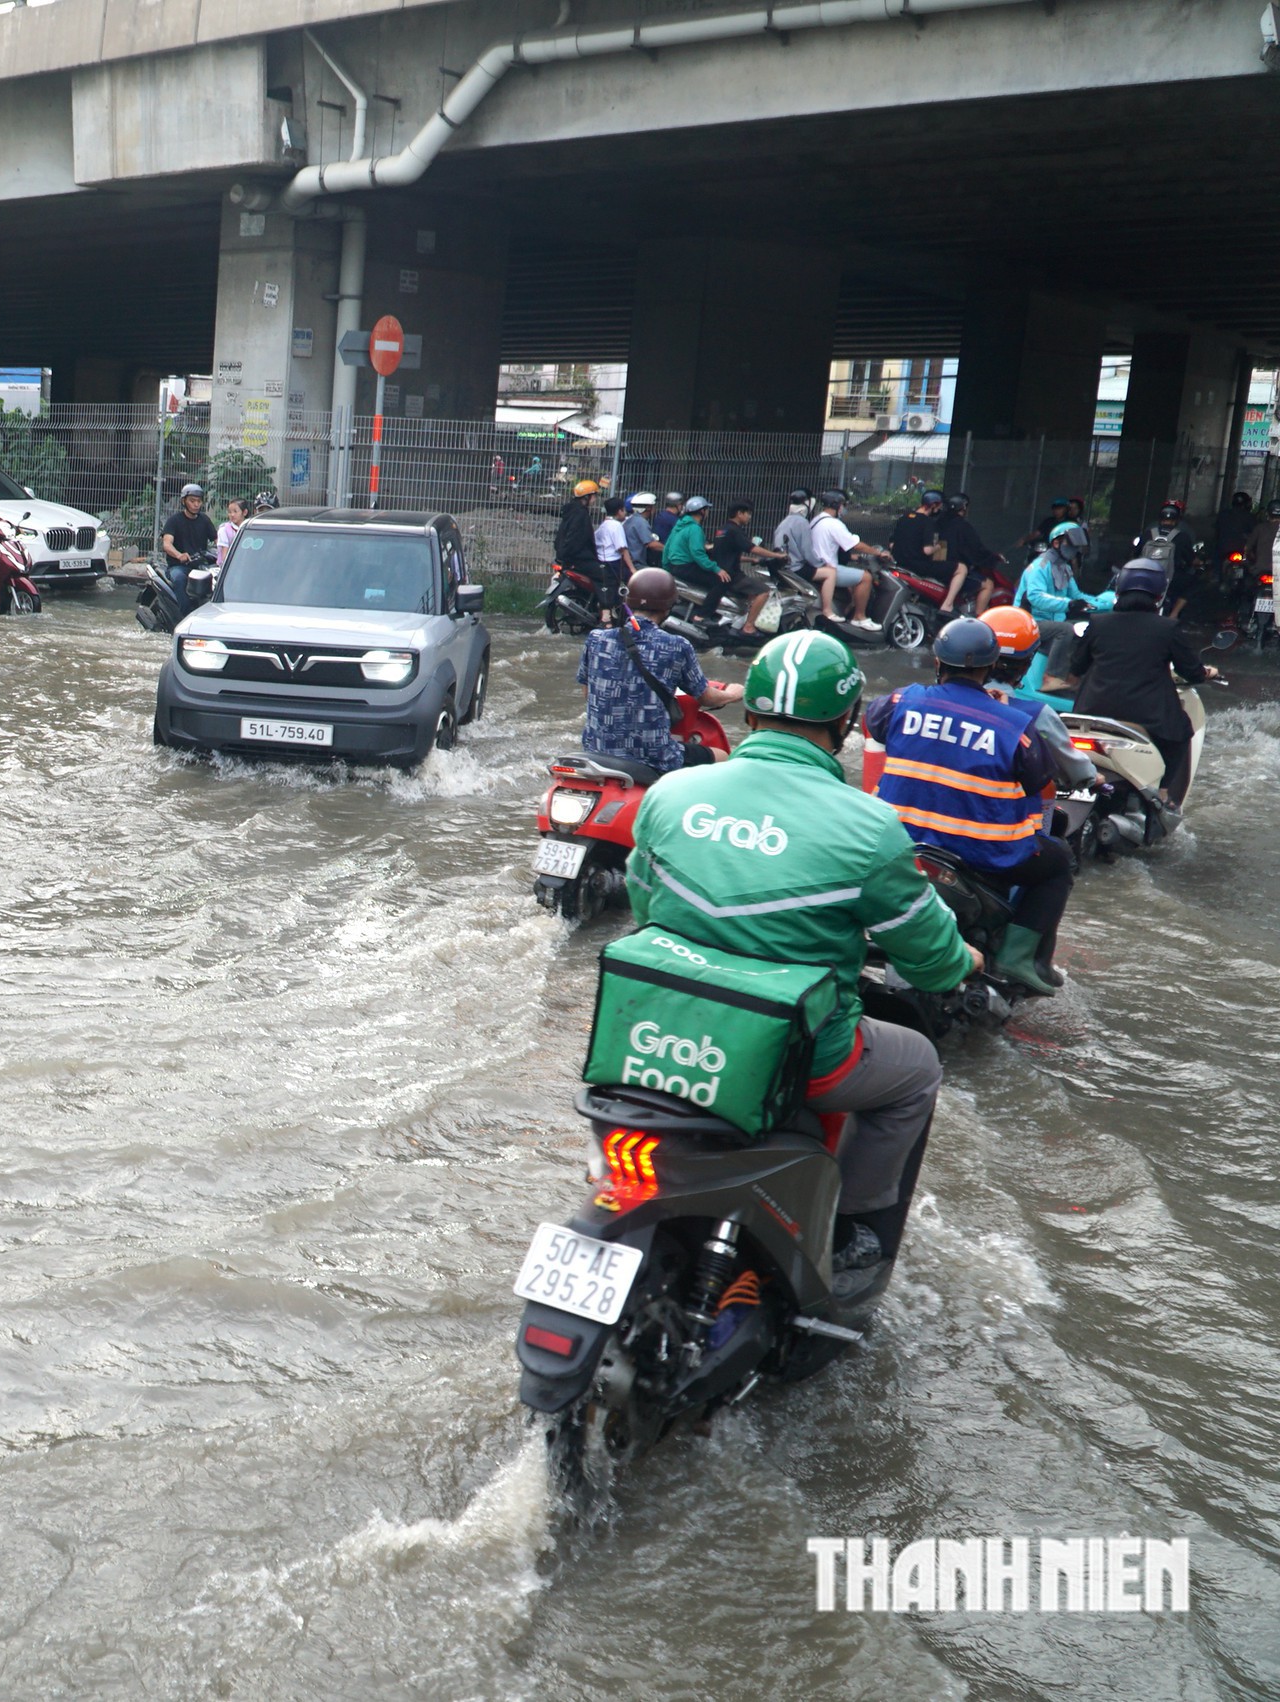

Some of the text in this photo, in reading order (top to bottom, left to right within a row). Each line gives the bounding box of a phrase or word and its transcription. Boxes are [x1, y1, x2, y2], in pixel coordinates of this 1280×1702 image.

[1245, 408, 1263, 425] IỆN
[249, 723, 325, 741] 51L-759.40
[902, 710, 996, 756] DELTA
[543, 842, 577, 861] 59-S1
[682, 803, 789, 856] Grab
[629, 1021, 727, 1073] Grab
[622, 1055, 721, 1107] Food
[545, 1233, 625, 1281] 50-AE
[524, 1263, 618, 1316] 295.28
